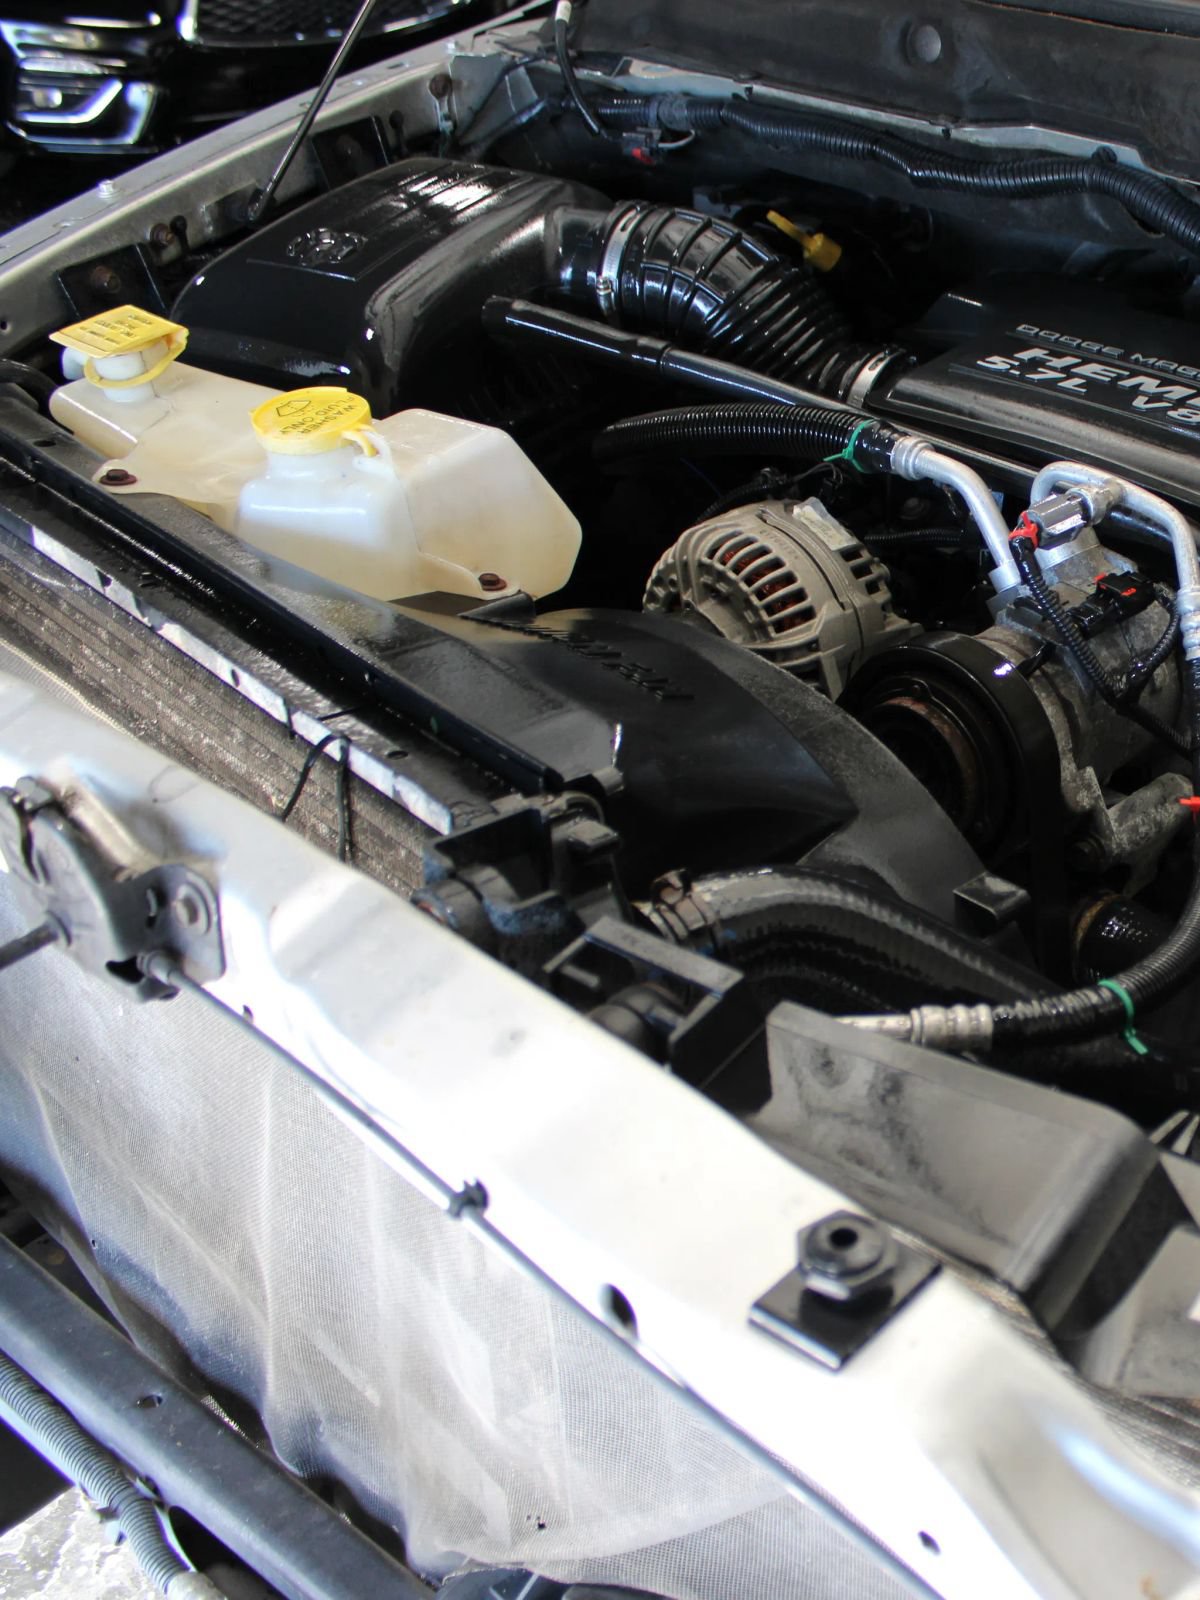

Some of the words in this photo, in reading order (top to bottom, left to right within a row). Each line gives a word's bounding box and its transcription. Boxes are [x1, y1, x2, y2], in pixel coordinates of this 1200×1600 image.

[1016, 323, 1125, 359] DODGE
[976, 355, 1088, 395] 5.7L
[298, 404, 357, 434] WASHER
[316, 396, 356, 416] FLUID
[280, 416, 314, 434] ONLY
